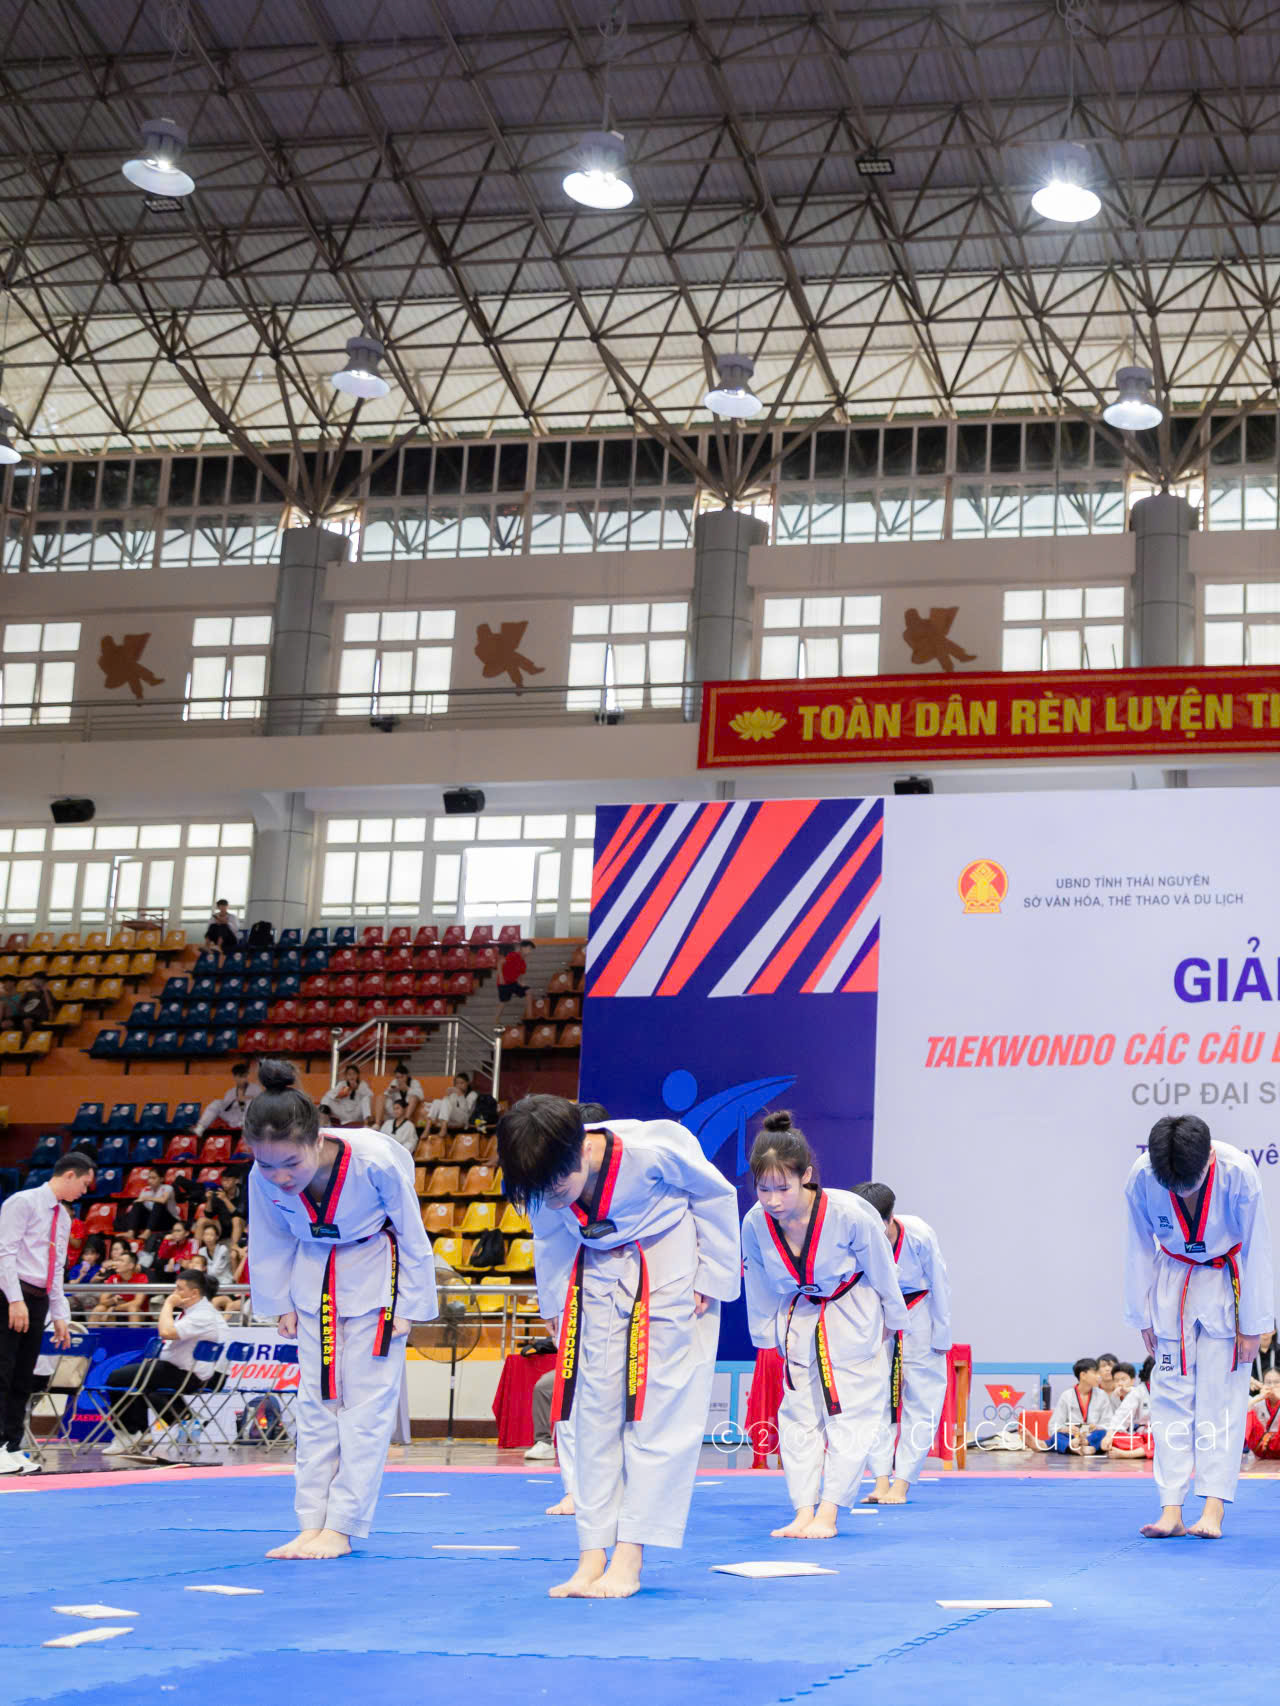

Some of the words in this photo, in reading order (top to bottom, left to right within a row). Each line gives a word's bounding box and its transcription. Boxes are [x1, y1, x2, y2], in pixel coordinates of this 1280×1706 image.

[799, 697, 902, 741] TOÀN
[914, 694, 998, 738] DÂN
[1011, 691, 1091, 736] RÈN
[1105, 687, 1234, 740] LUYỆN
[1056, 877, 1091, 889] UBND
[1126, 874, 1155, 887] THÁI
[1158, 873, 1210, 887] NGUYÊN
[1136, 894, 1171, 906] THAO
[1174, 891, 1191, 905] VÀ
[1194, 894, 1212, 905] DU
[1215, 893, 1244, 907] LỊCH
[925, 1033, 1115, 1069] TAEKWONDO
[1123, 1024, 1190, 1066] CÁC
[1198, 1025, 1266, 1064] CÂU
[1131, 1077, 1192, 1107] CÚP
[1200, 1080, 1251, 1110] ĐẠI
[561, 1286, 580, 1379] TAEKWONDO
